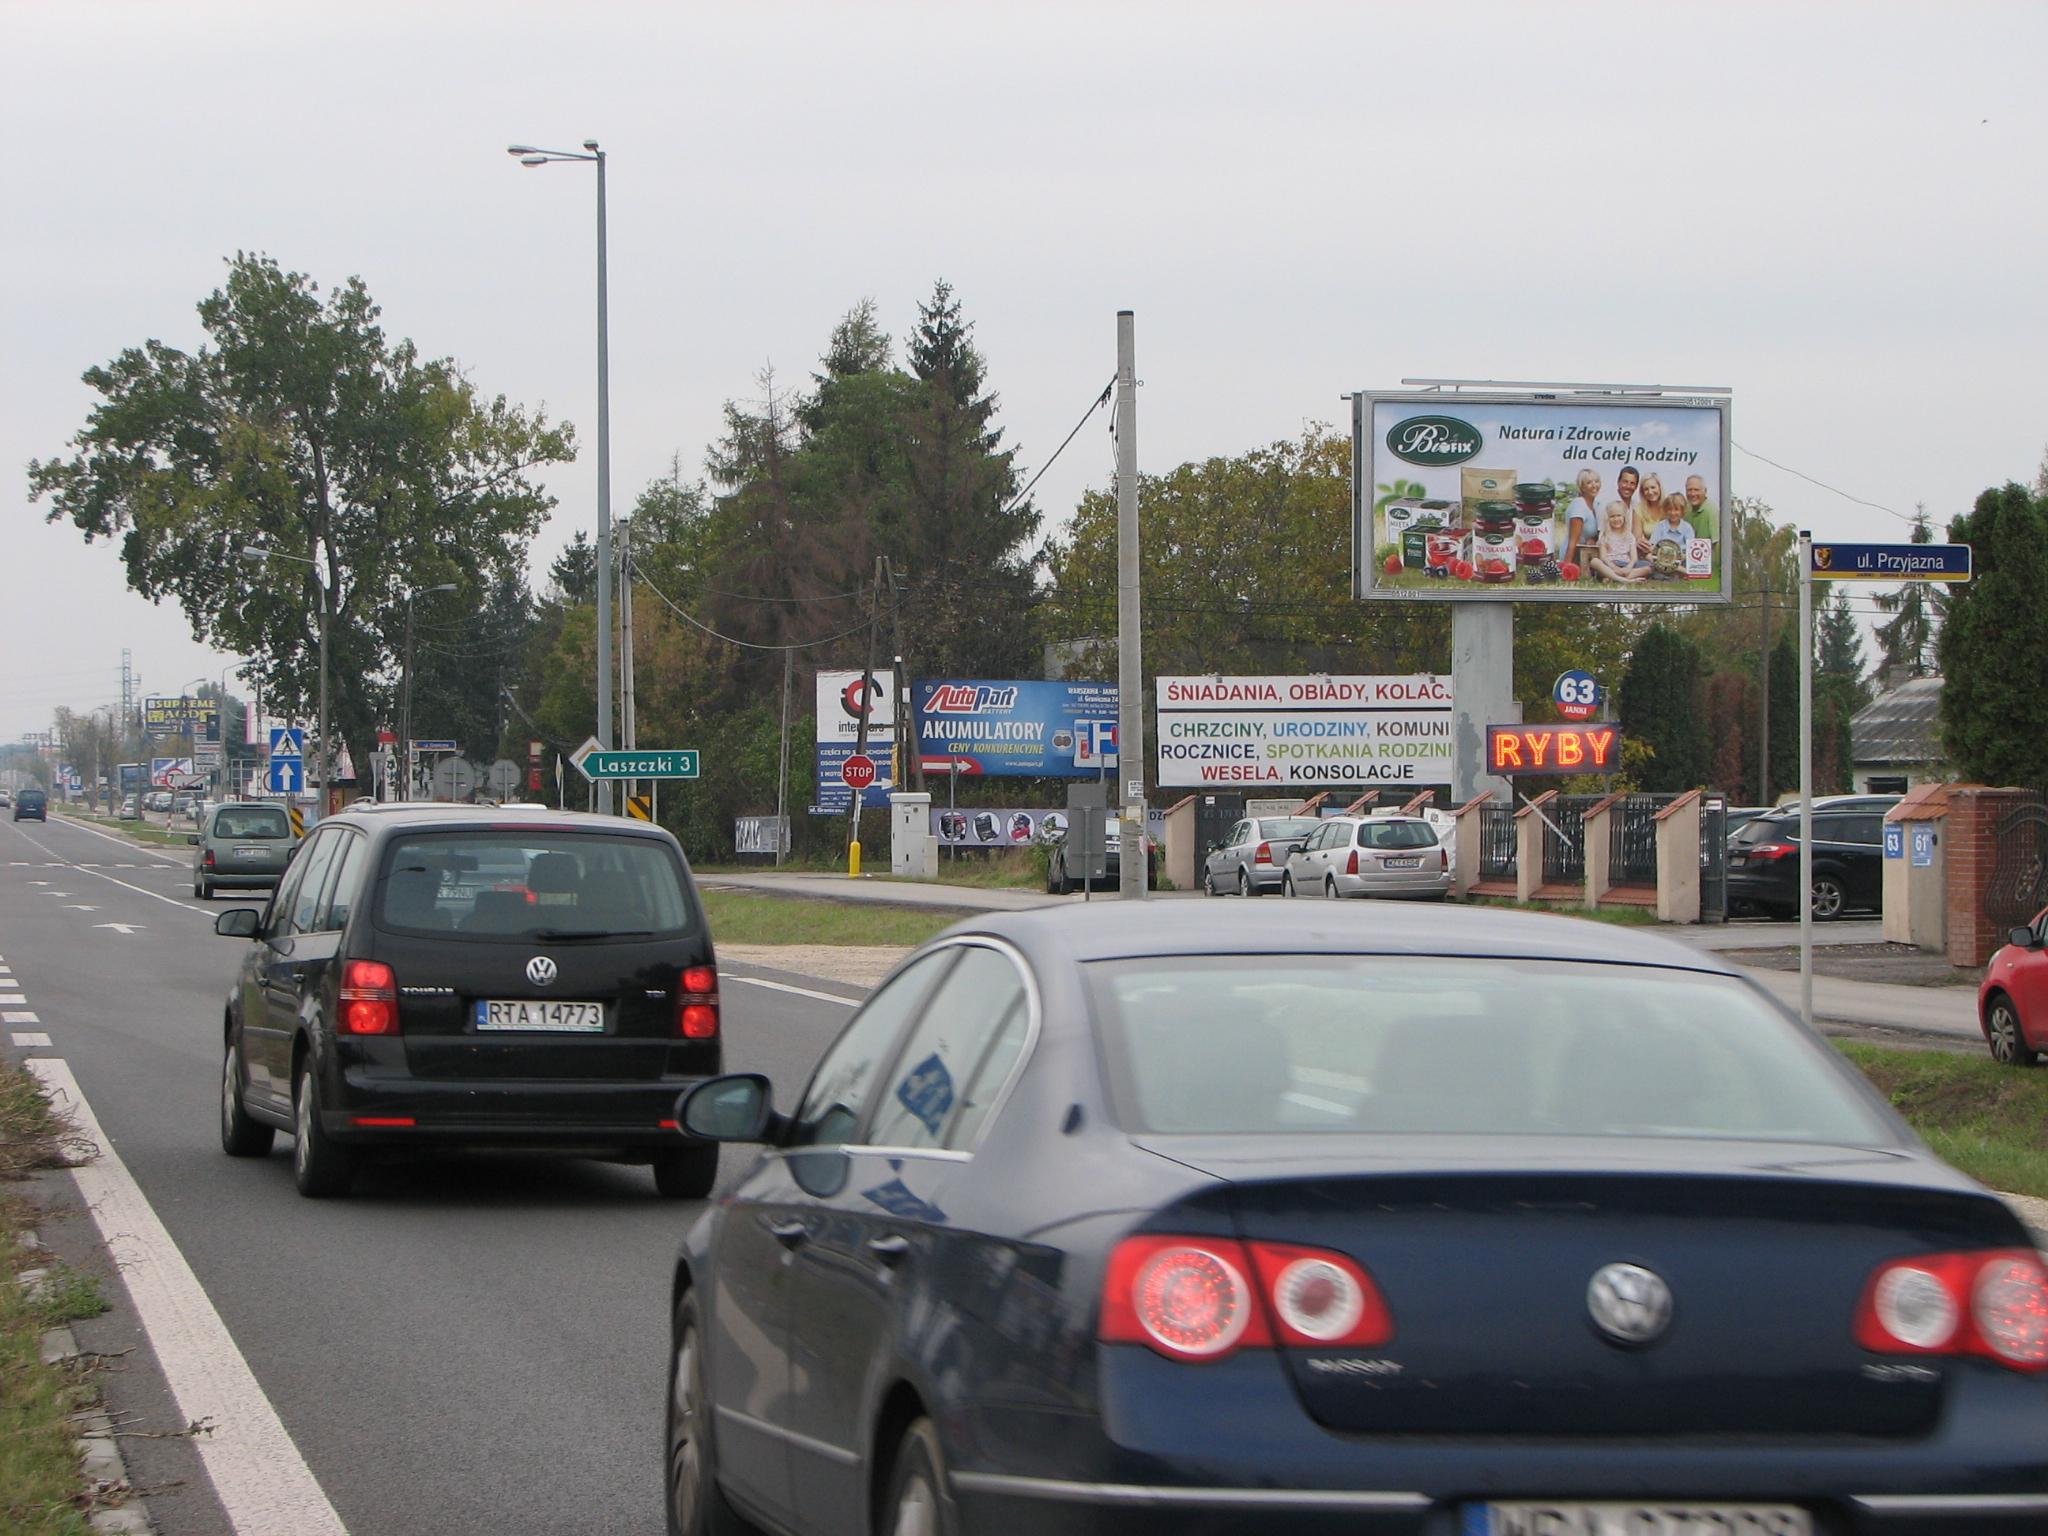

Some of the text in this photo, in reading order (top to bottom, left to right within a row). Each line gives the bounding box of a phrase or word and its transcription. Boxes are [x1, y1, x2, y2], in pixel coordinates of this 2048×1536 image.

[1498, 425, 1631, 442] Natura i Zdrowie
[1562, 445, 1698, 465] dla Całej Rodziny
[1857, 553, 1944, 572] ul. Przyjazna
[1167, 681, 1283, 703] ŚNIADANIA,
[1289, 684, 1369, 702] OBIADY,
[1560, 677, 1595, 704] 63
[1564, 705, 1587, 715] JANKI
[922, 720, 1044, 740] AKUMULATORY
[1170, 722, 1267, 739] CHRZCINY,
[1273, 722, 1370, 739] URODZINY,
[948, 742, 1044, 754] CENY KONKURENCYJNE
[1160, 744, 1260, 761] ROCZNICE,
[1266, 743, 1373, 759] SPOTKANIA
[1495, 731, 1613, 766] RYBY
[599, 756, 691, 773] Laszczki 3
[845, 766, 873, 778] STOP
[1201, 764, 1414, 782] WESELA, KONSOLACJE
[1887, 834, 1899, 852] 63
[538, 1003, 601, 1024] 14773
